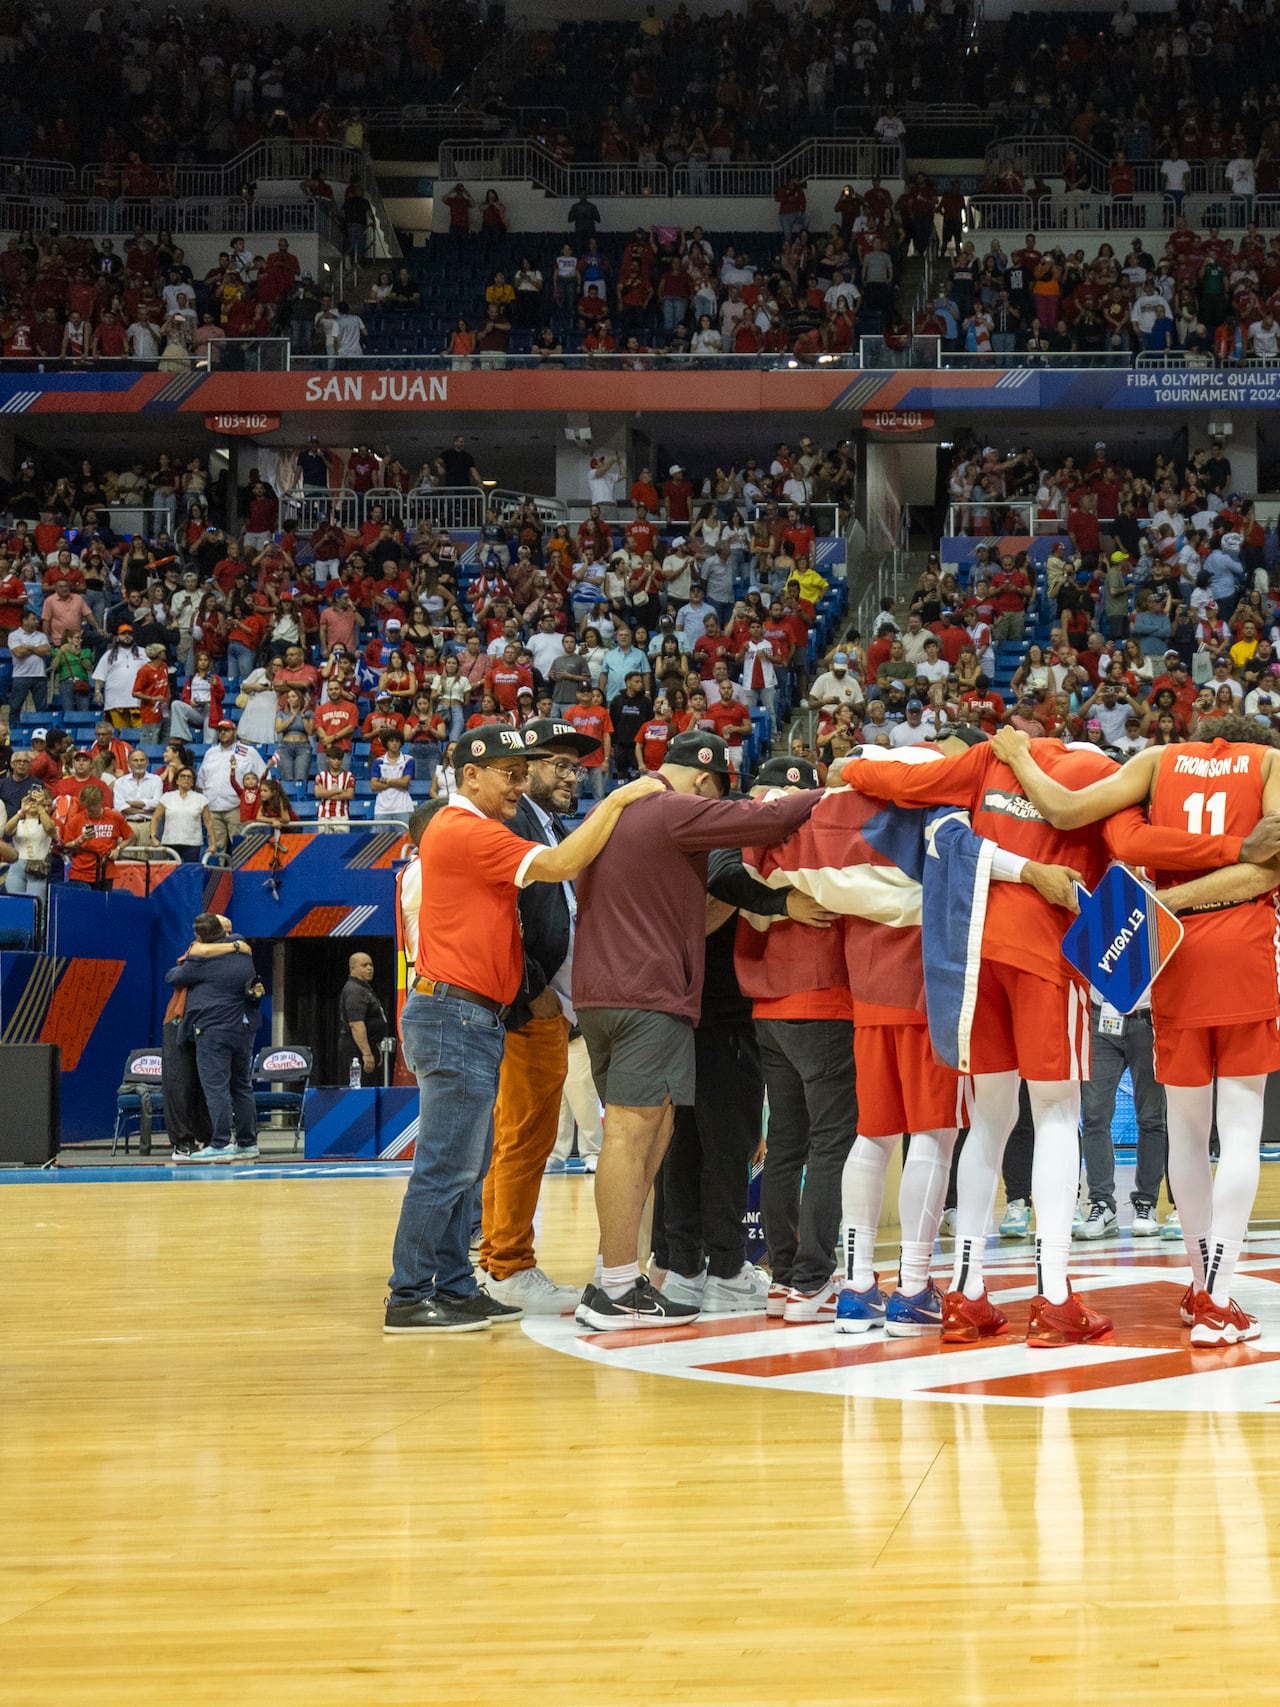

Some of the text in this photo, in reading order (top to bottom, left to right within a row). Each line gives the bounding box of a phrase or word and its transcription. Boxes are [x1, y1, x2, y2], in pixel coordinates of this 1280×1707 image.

[1127, 374, 1158, 387] FIBA
[1161, 373, 1224, 387] OLYMPIC
[305, 376, 448, 402] SAN JUAN
[1155, 388, 1247, 402] TOURNAMENT
[217, 414, 268, 429] 103-102
[875, 412, 922, 426] 102-101
[971, 701, 993, 709] PUR
[1174, 754, 1250, 778] THOMSON JR
[1183, 791, 1227, 836] 11
[1097, 908, 1146, 974] ET VOILA
